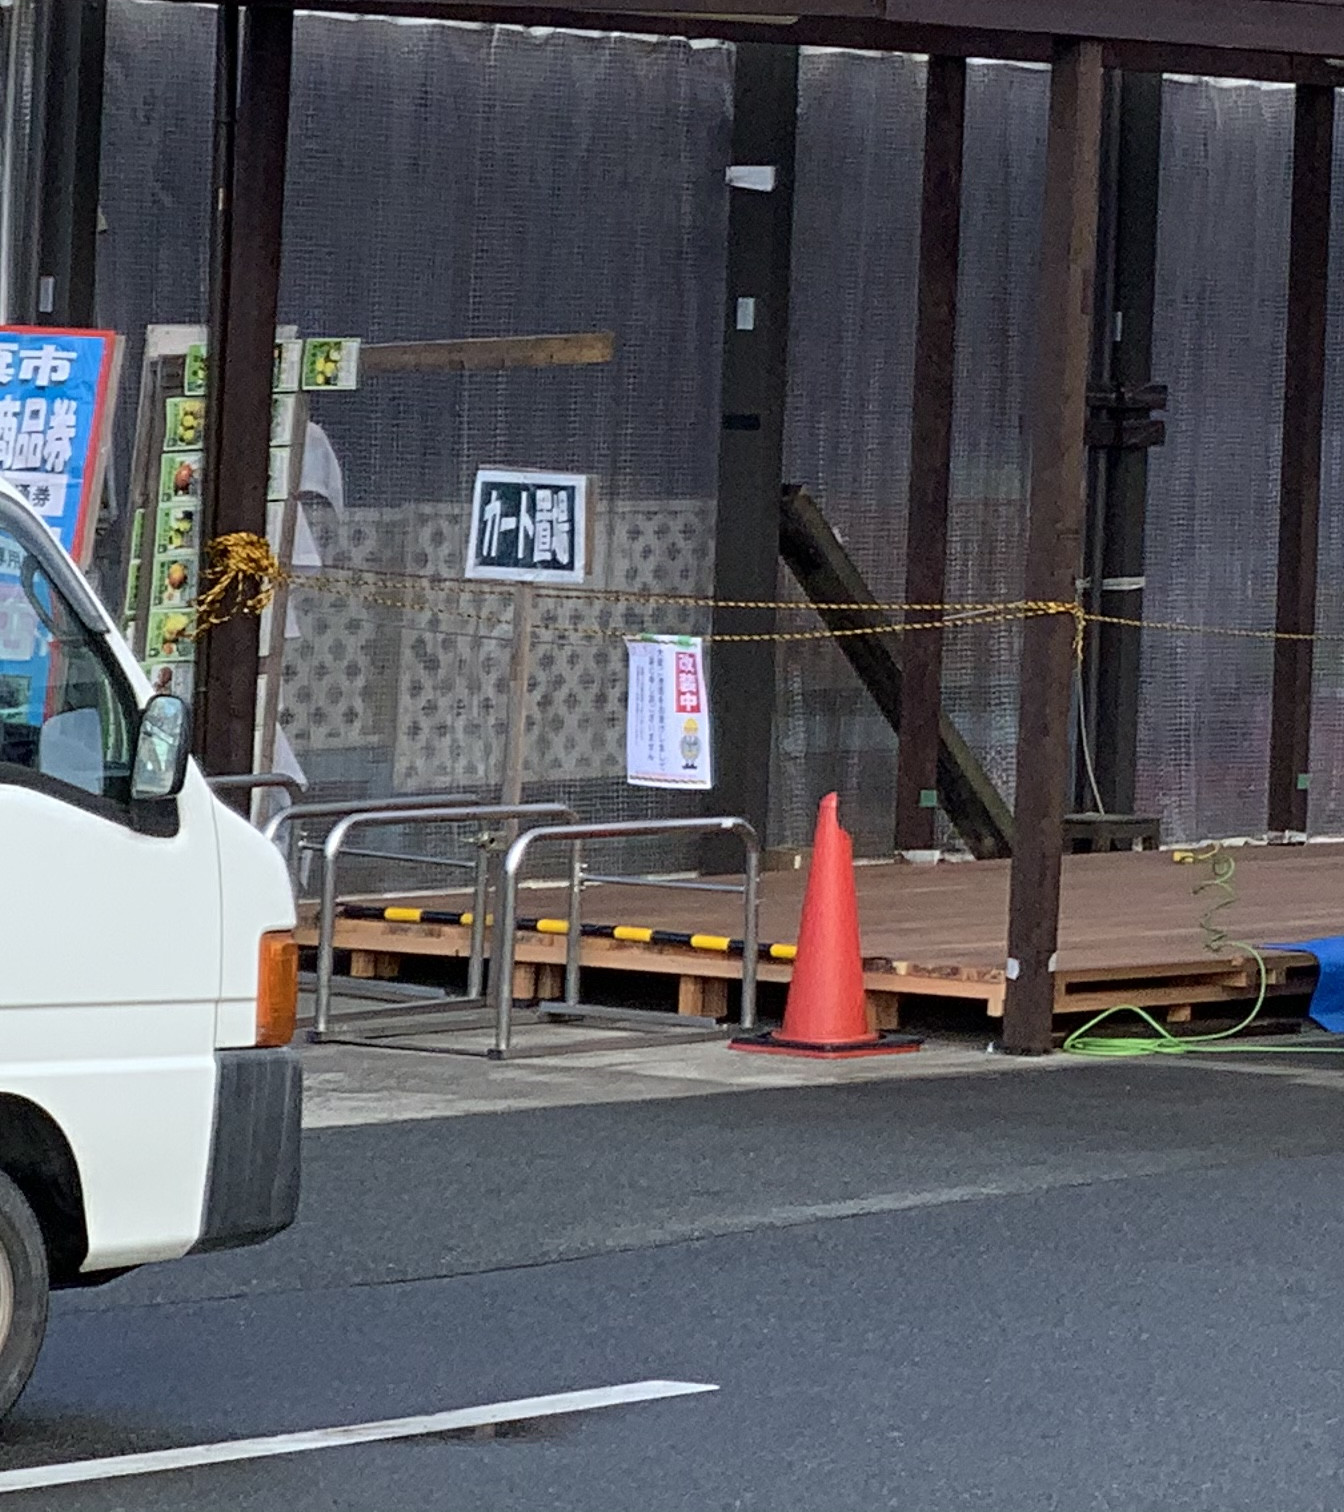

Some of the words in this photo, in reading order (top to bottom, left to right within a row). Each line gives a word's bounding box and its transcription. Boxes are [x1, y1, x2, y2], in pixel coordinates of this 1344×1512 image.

[482, 489, 570, 566] カート置場
